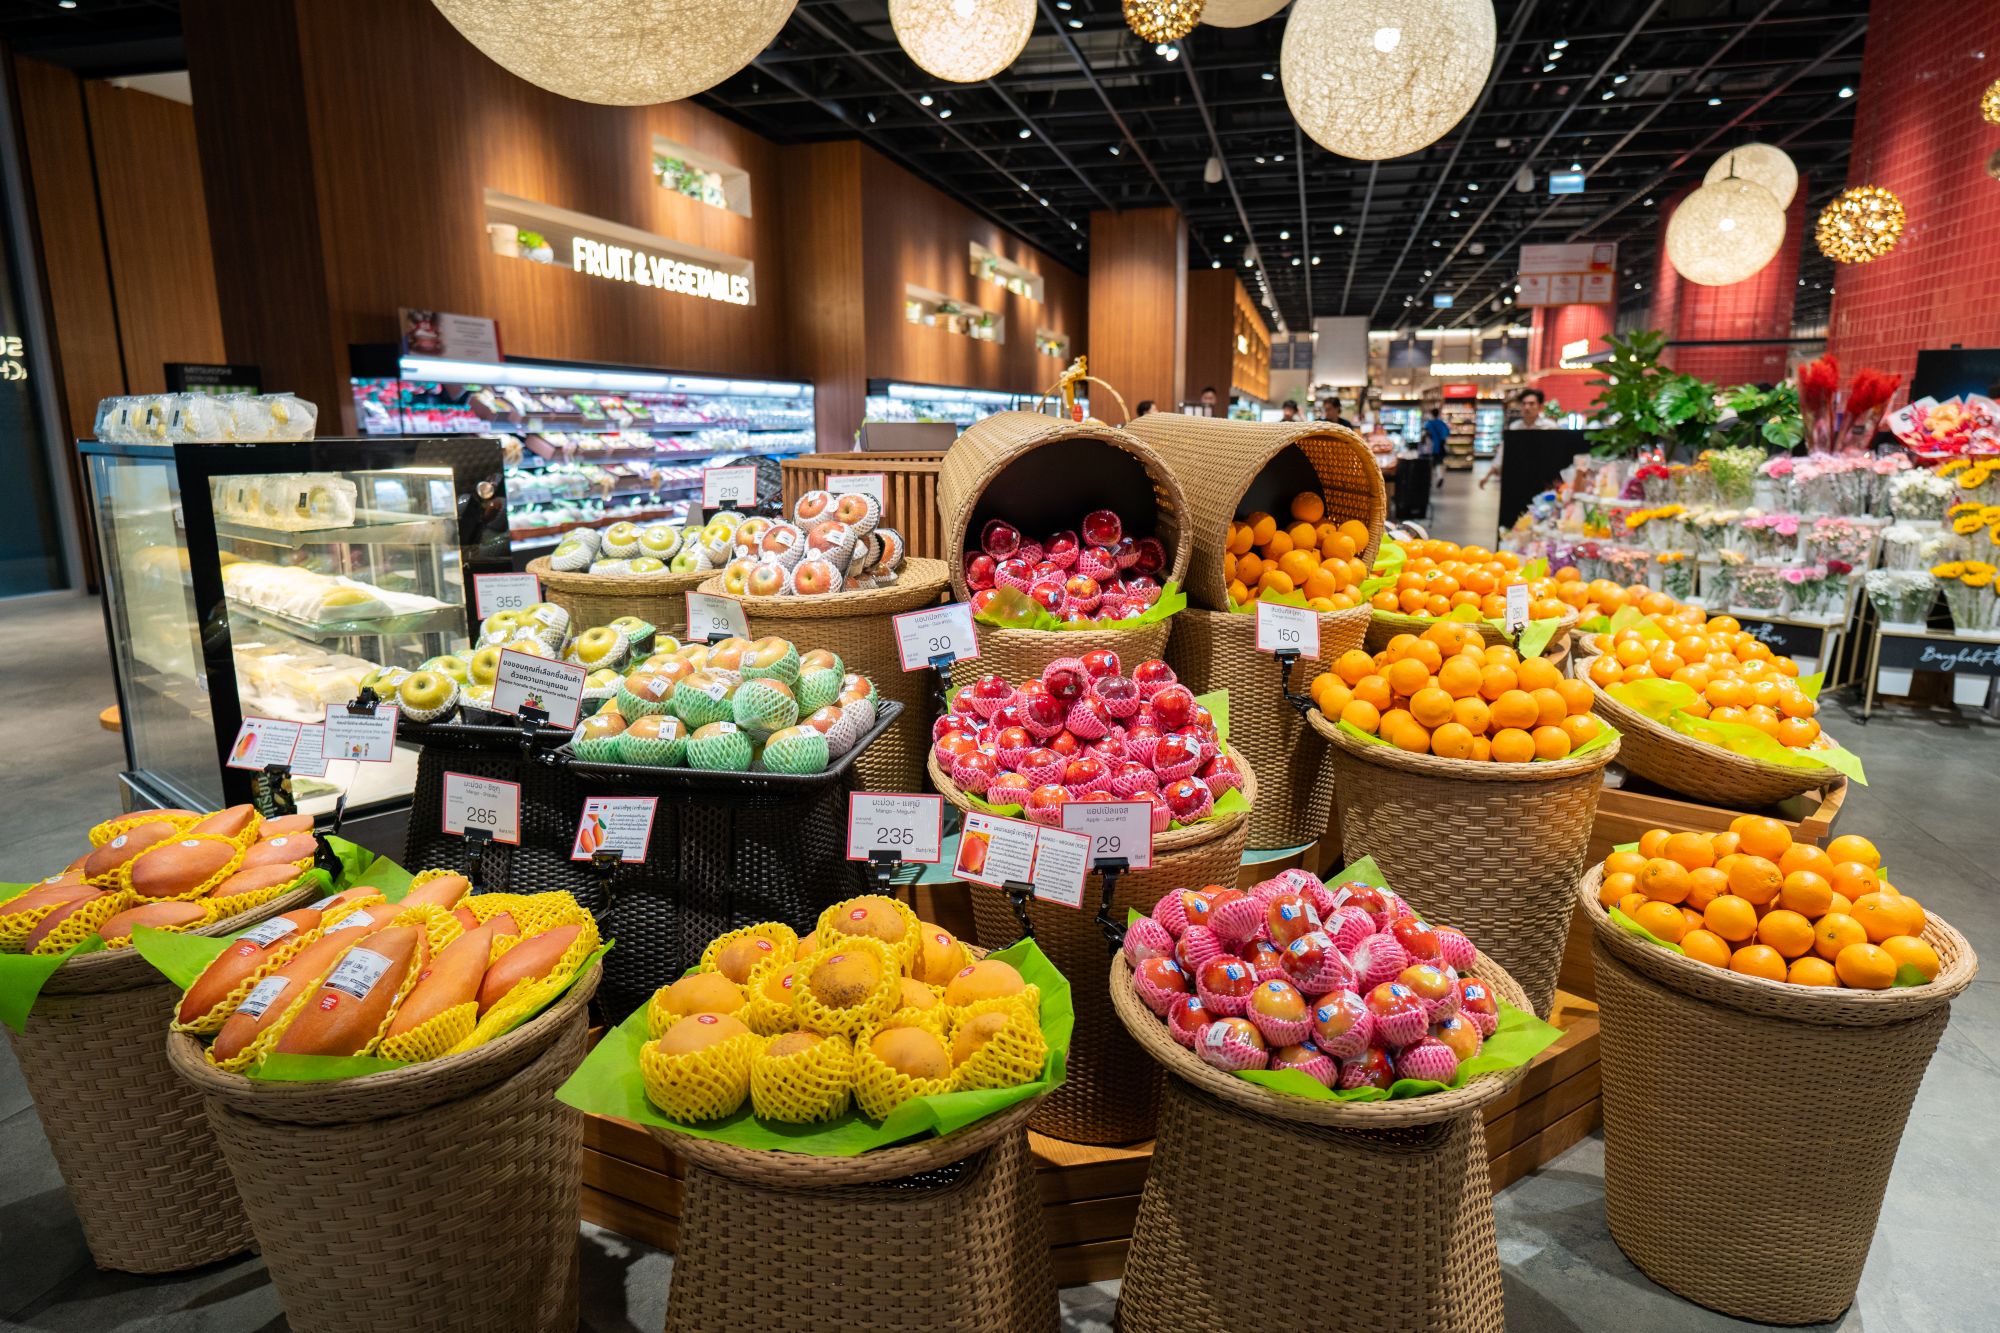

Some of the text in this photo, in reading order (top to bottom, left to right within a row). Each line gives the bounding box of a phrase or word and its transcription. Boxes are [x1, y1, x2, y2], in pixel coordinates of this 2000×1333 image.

[572, 237, 749, 305] FRUIT & VEGETABLES
[720, 487, 739, 498] 219
[496, 596, 522, 608] 355
[712, 617, 729, 630] 99
[928, 635, 951, 652] 30
[1278, 628, 1300, 643] 150
[872, 797, 895, 807] มะม่วง
[467, 806, 497, 825] 285
[877, 827, 914, 845] 235
[1096, 836, 1121, 853] 29
